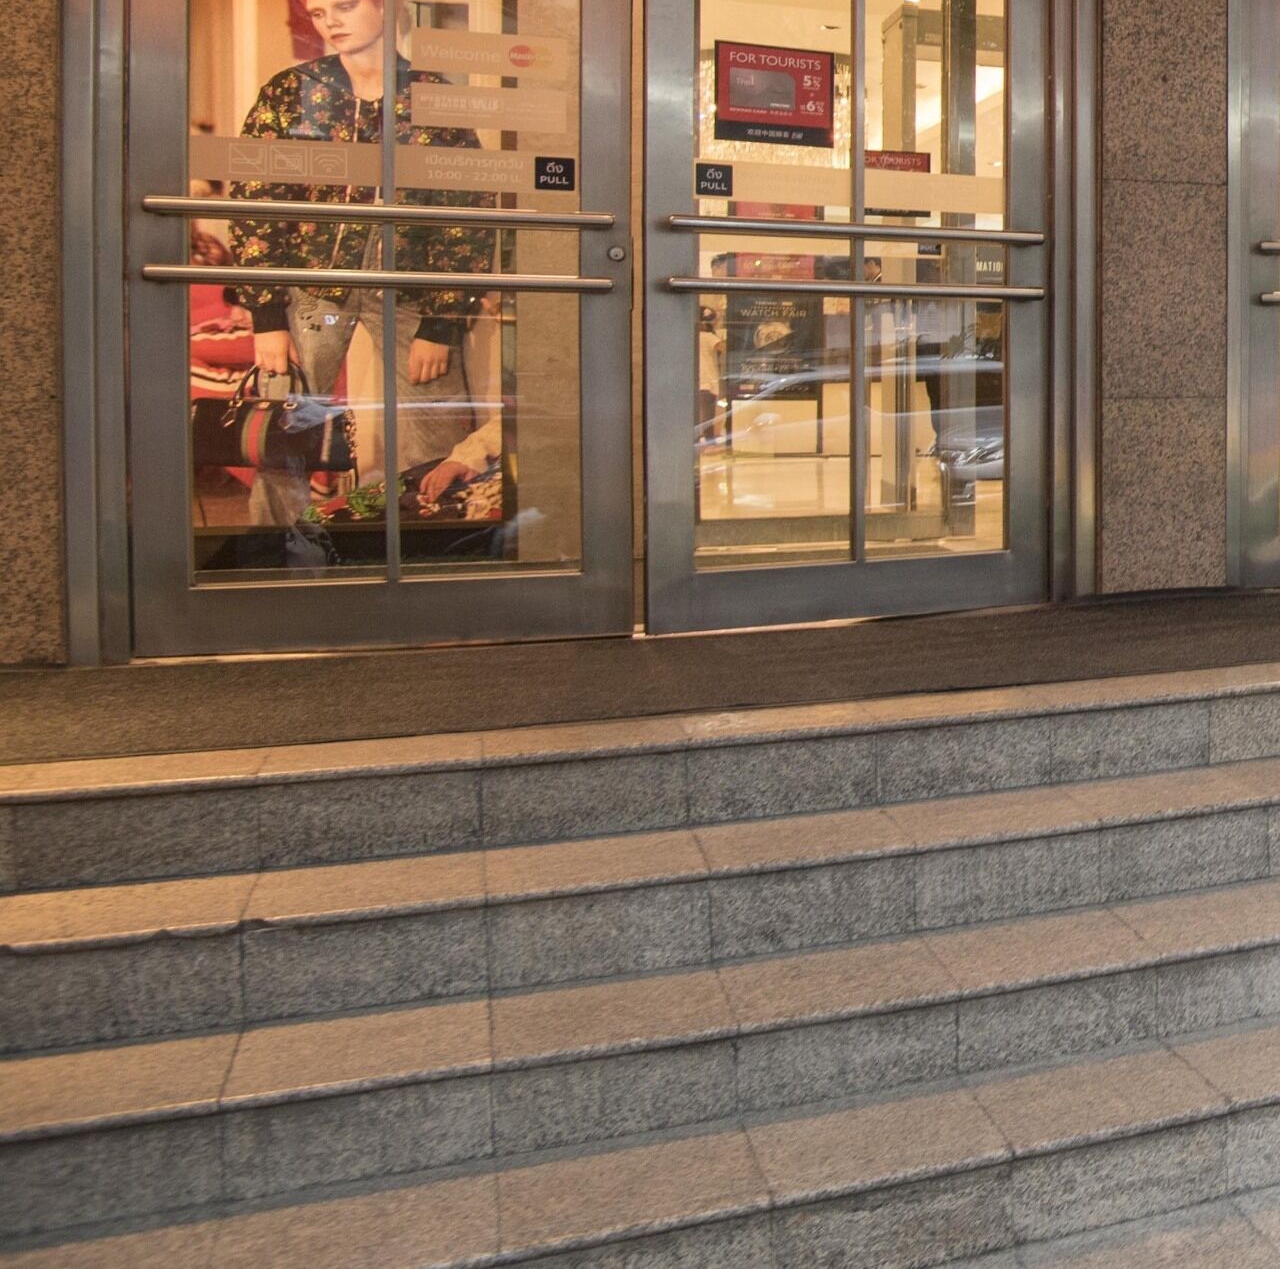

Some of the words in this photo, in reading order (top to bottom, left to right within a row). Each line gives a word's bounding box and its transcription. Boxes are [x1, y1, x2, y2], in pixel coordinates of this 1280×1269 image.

[420, 45, 502, 63] Welcome
[729, 51, 757, 64] FOR
[759, 54, 821, 71] TOURISTS
[545, 161, 565, 174] ดึง
[705, 167, 723, 180] ดึง
[540, 175, 569, 185] PULL
[700, 181, 728, 191] PULL
[976, 261, 1004, 272] MATIO
[741, 309, 780, 318] WATCH
